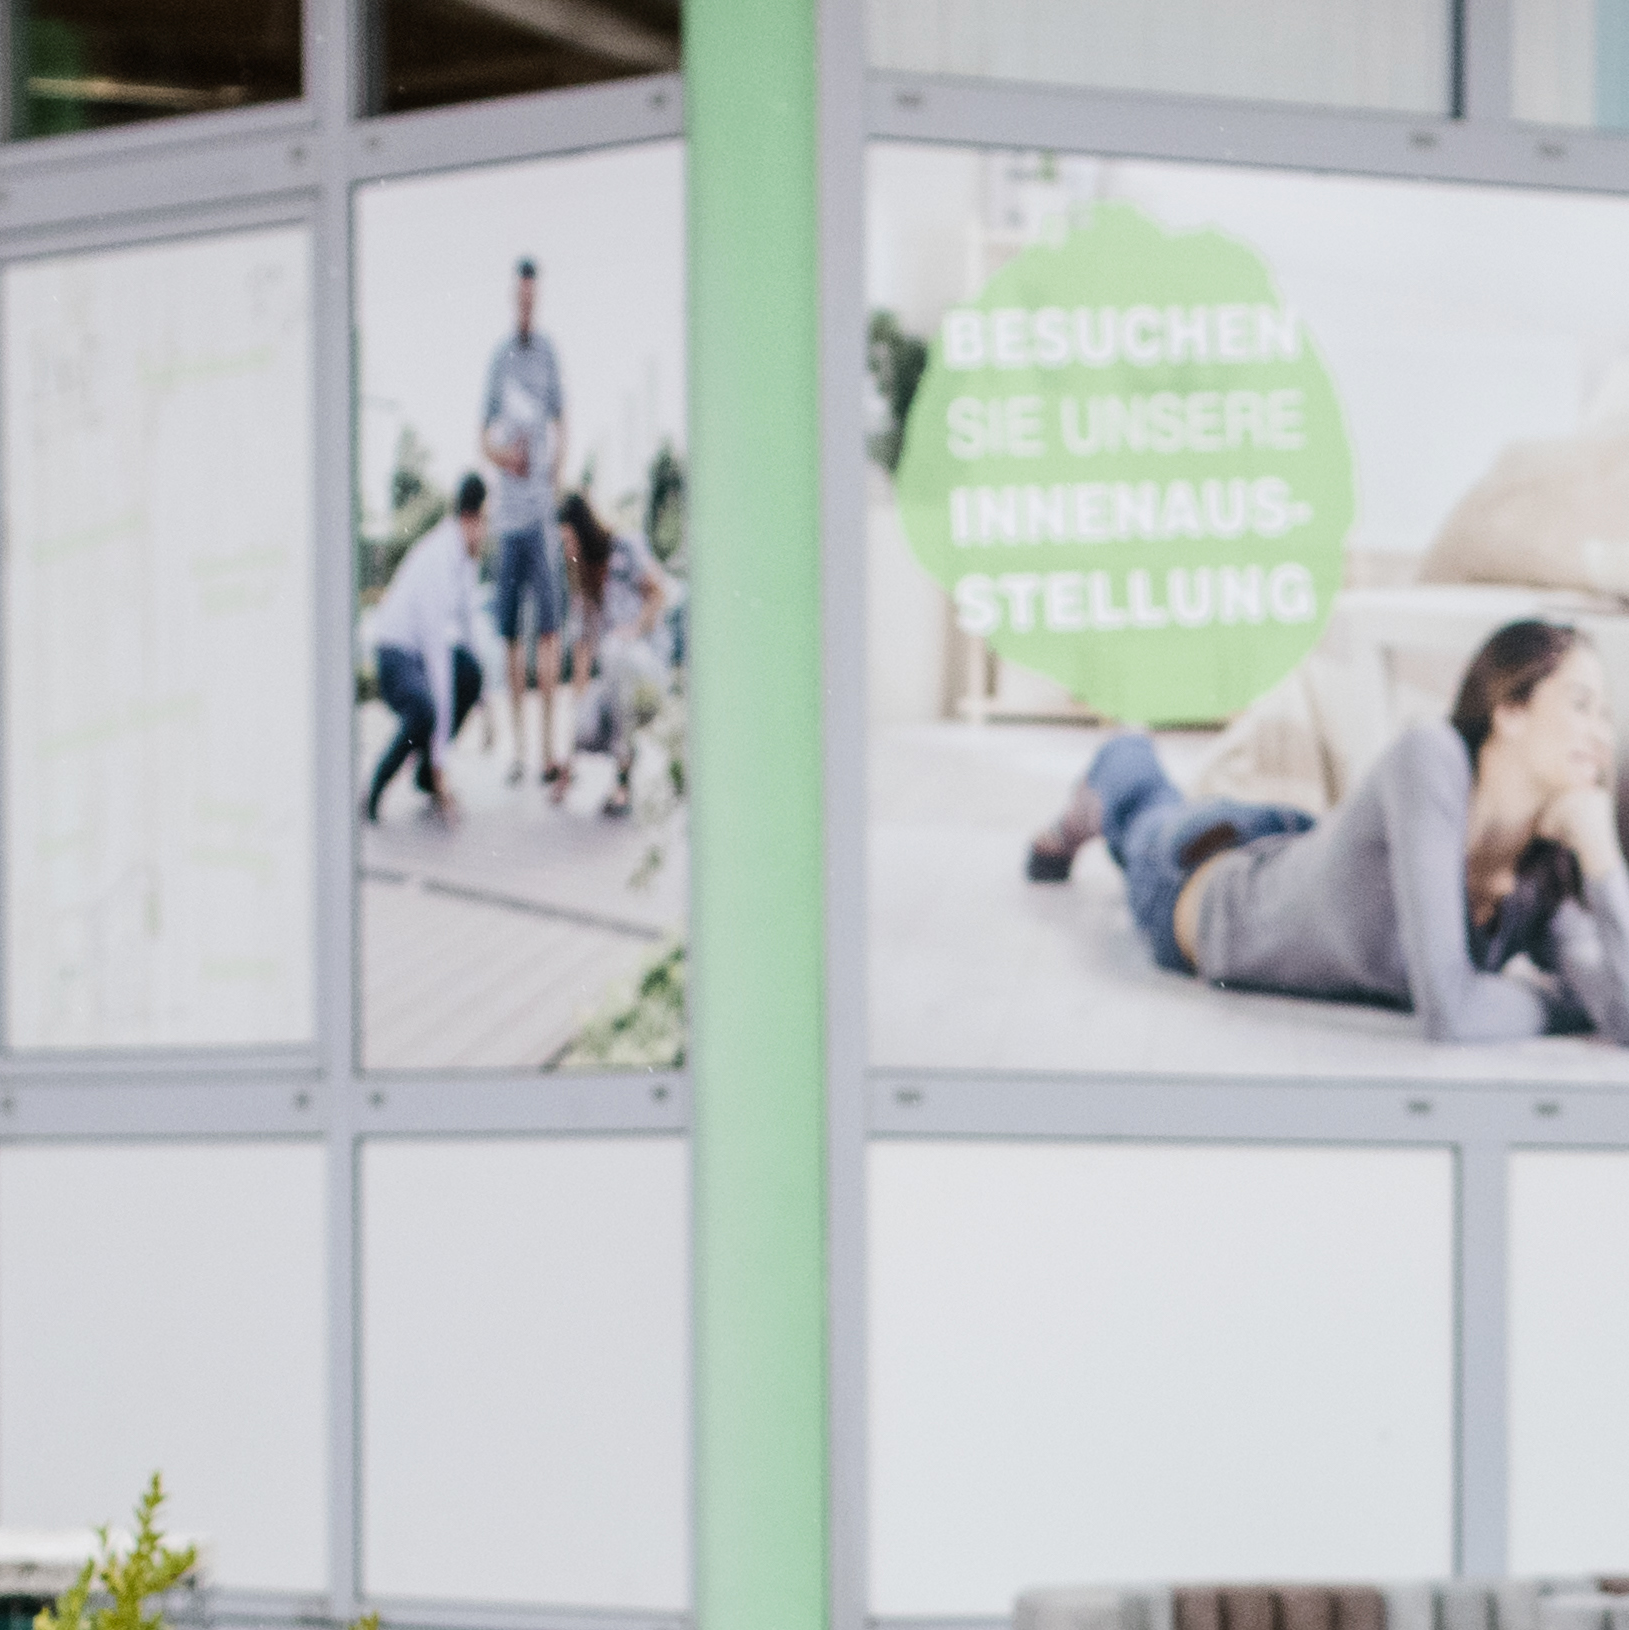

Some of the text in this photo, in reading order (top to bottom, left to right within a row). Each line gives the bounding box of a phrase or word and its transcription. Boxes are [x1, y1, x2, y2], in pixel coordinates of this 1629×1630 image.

[944, 305, 1301, 369] BESUCHEN
[946, 389, 1307, 459] SIE UNSERE
[950, 477, 1313, 547] INNENAUS-
[954, 562, 1317, 635] STELLUNG
